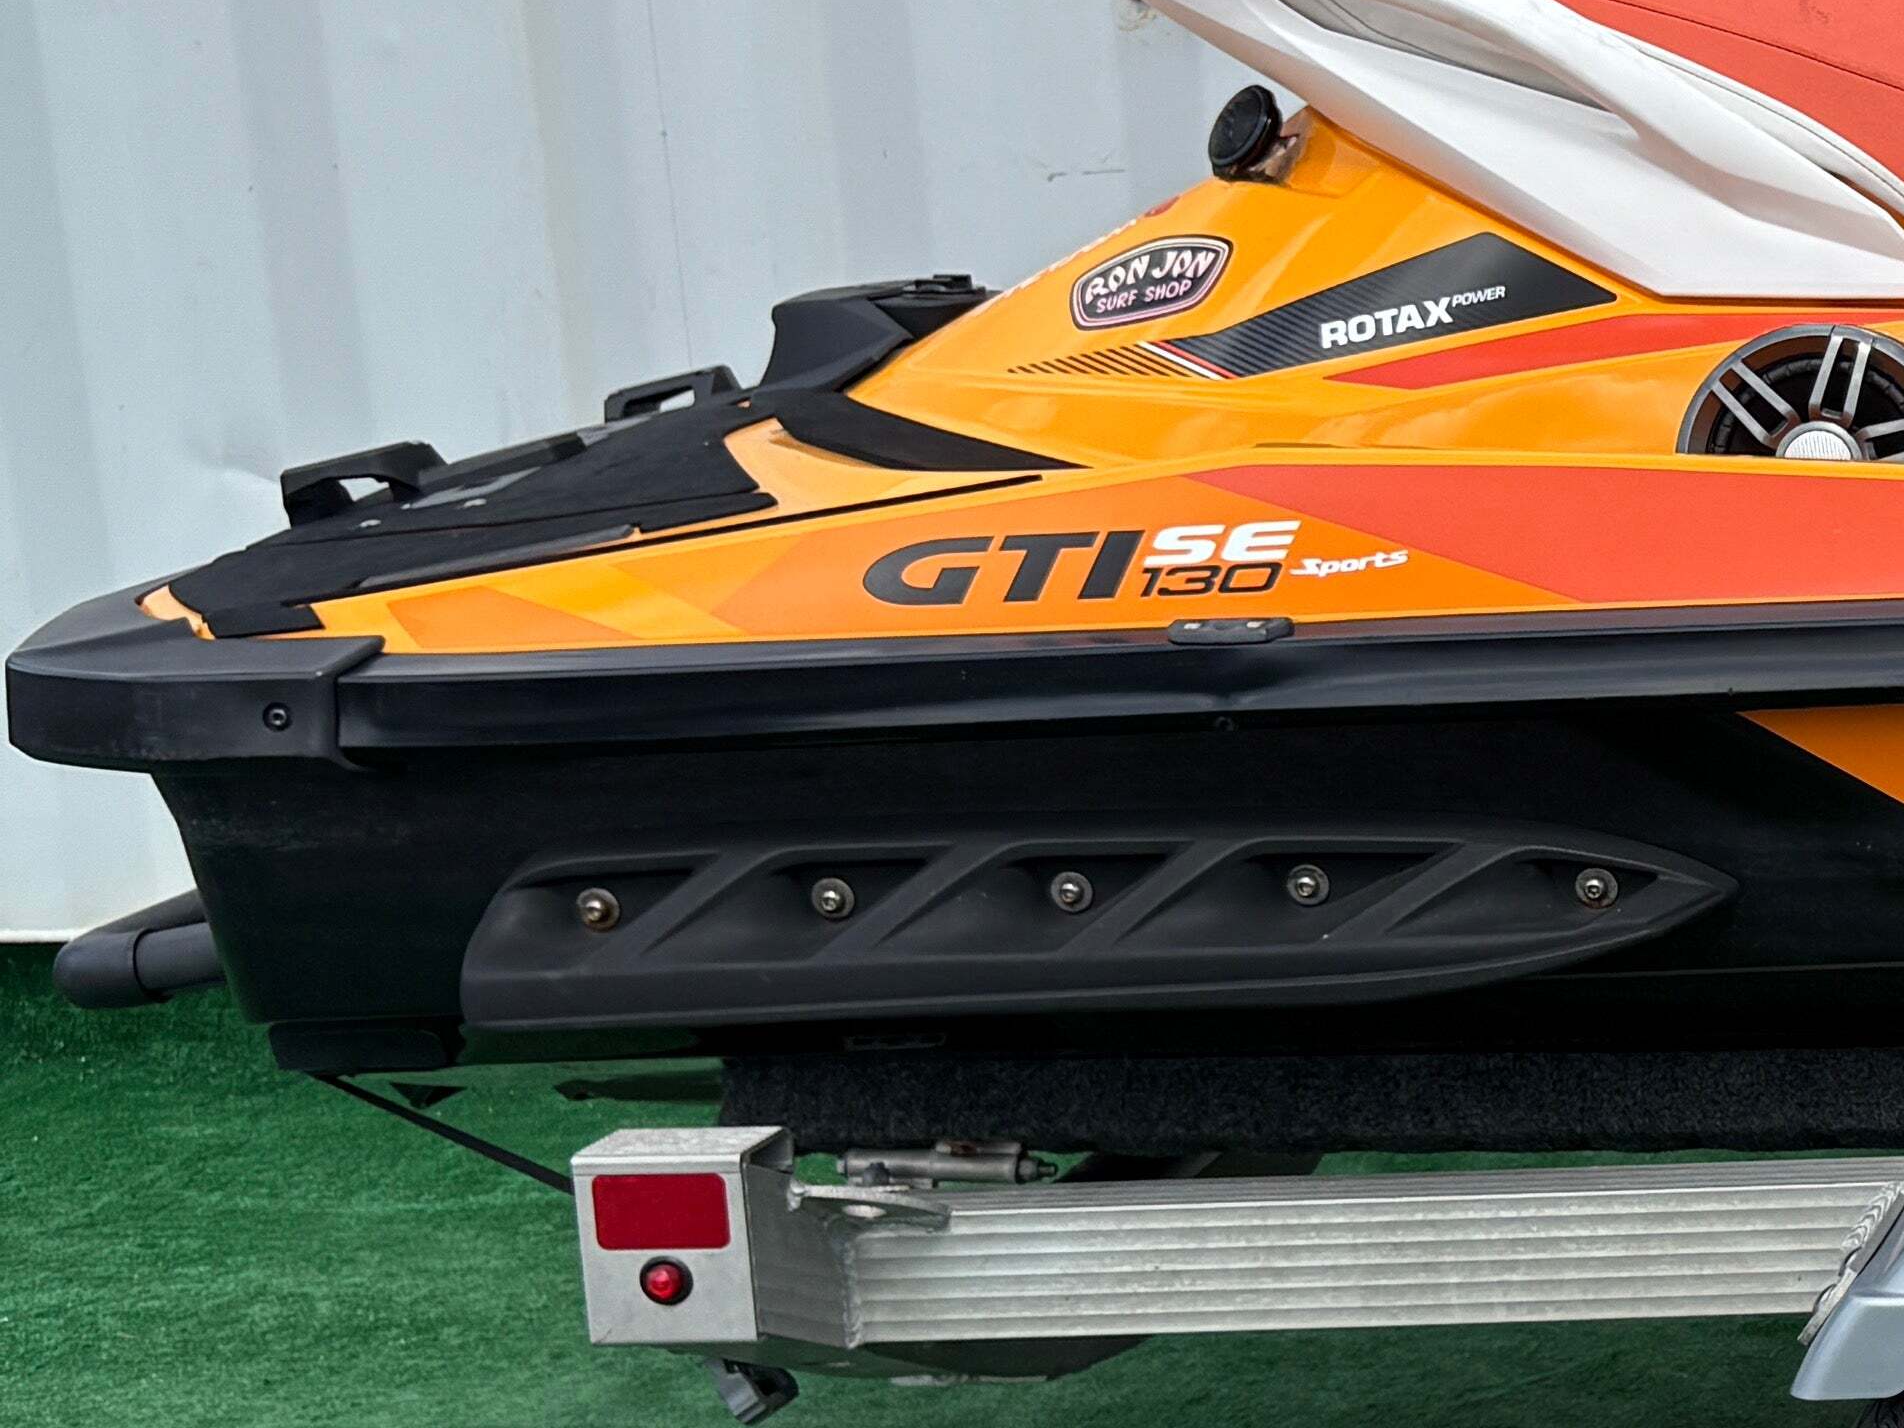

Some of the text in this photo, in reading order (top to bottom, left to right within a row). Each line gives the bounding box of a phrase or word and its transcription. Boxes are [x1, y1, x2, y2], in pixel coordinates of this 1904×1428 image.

[1085, 253, 1151, 306] RON
[1151, 249, 1217, 281] JON
[1095, 278, 1193, 314] SURF SHOP
[1320, 284, 1507, 350] ROTAX POWER
[862, 520, 1303, 607] GTI SE
[1139, 547, 1411, 598] 130 Sports
